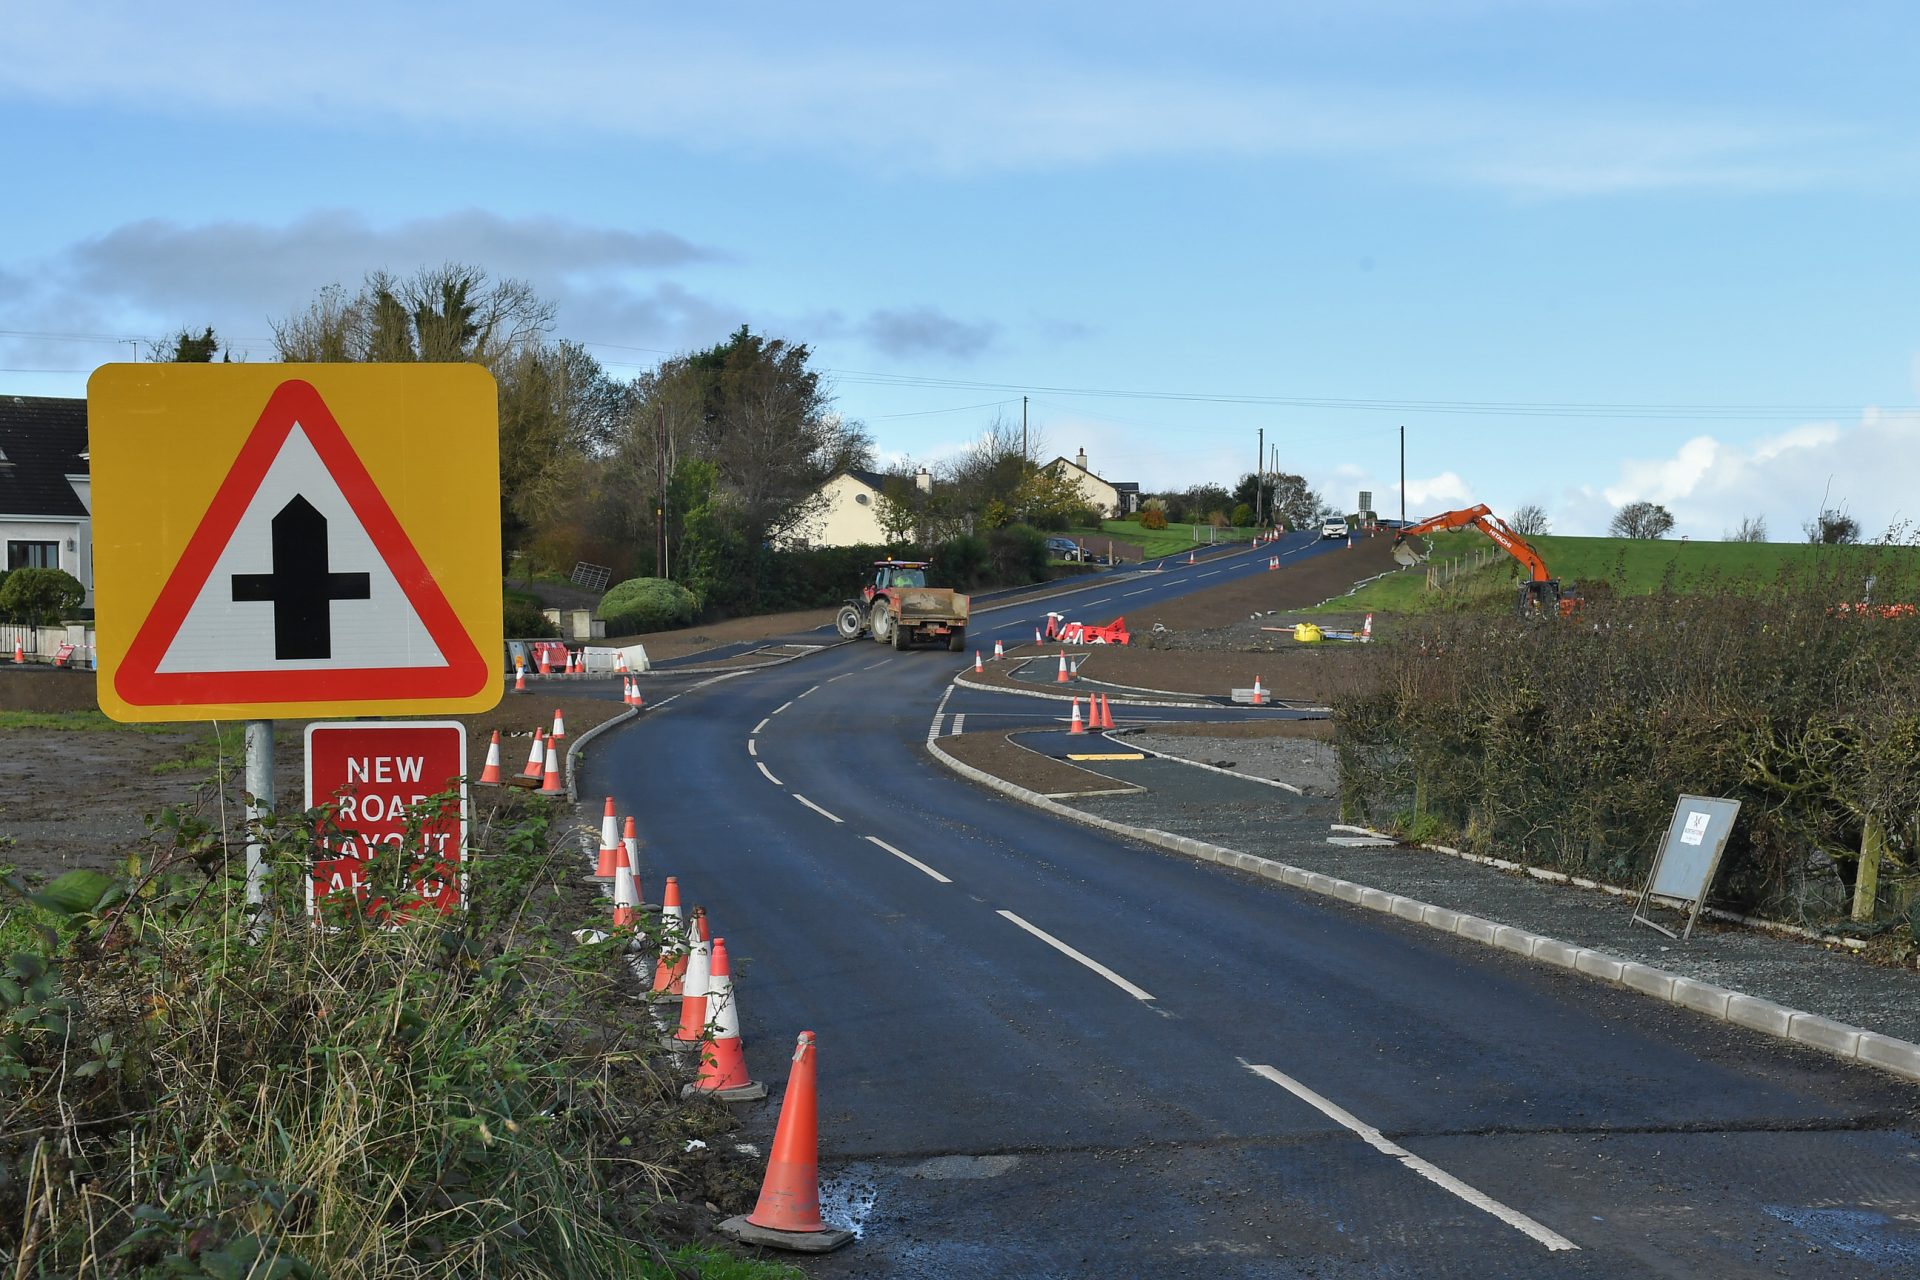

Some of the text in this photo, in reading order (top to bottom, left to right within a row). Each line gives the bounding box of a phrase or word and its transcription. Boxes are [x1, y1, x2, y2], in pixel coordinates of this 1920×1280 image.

[1488, 528, 1512, 548] HITACHI
[347, 756, 424, 783] NEW
[328, 872, 445, 898] AHD
